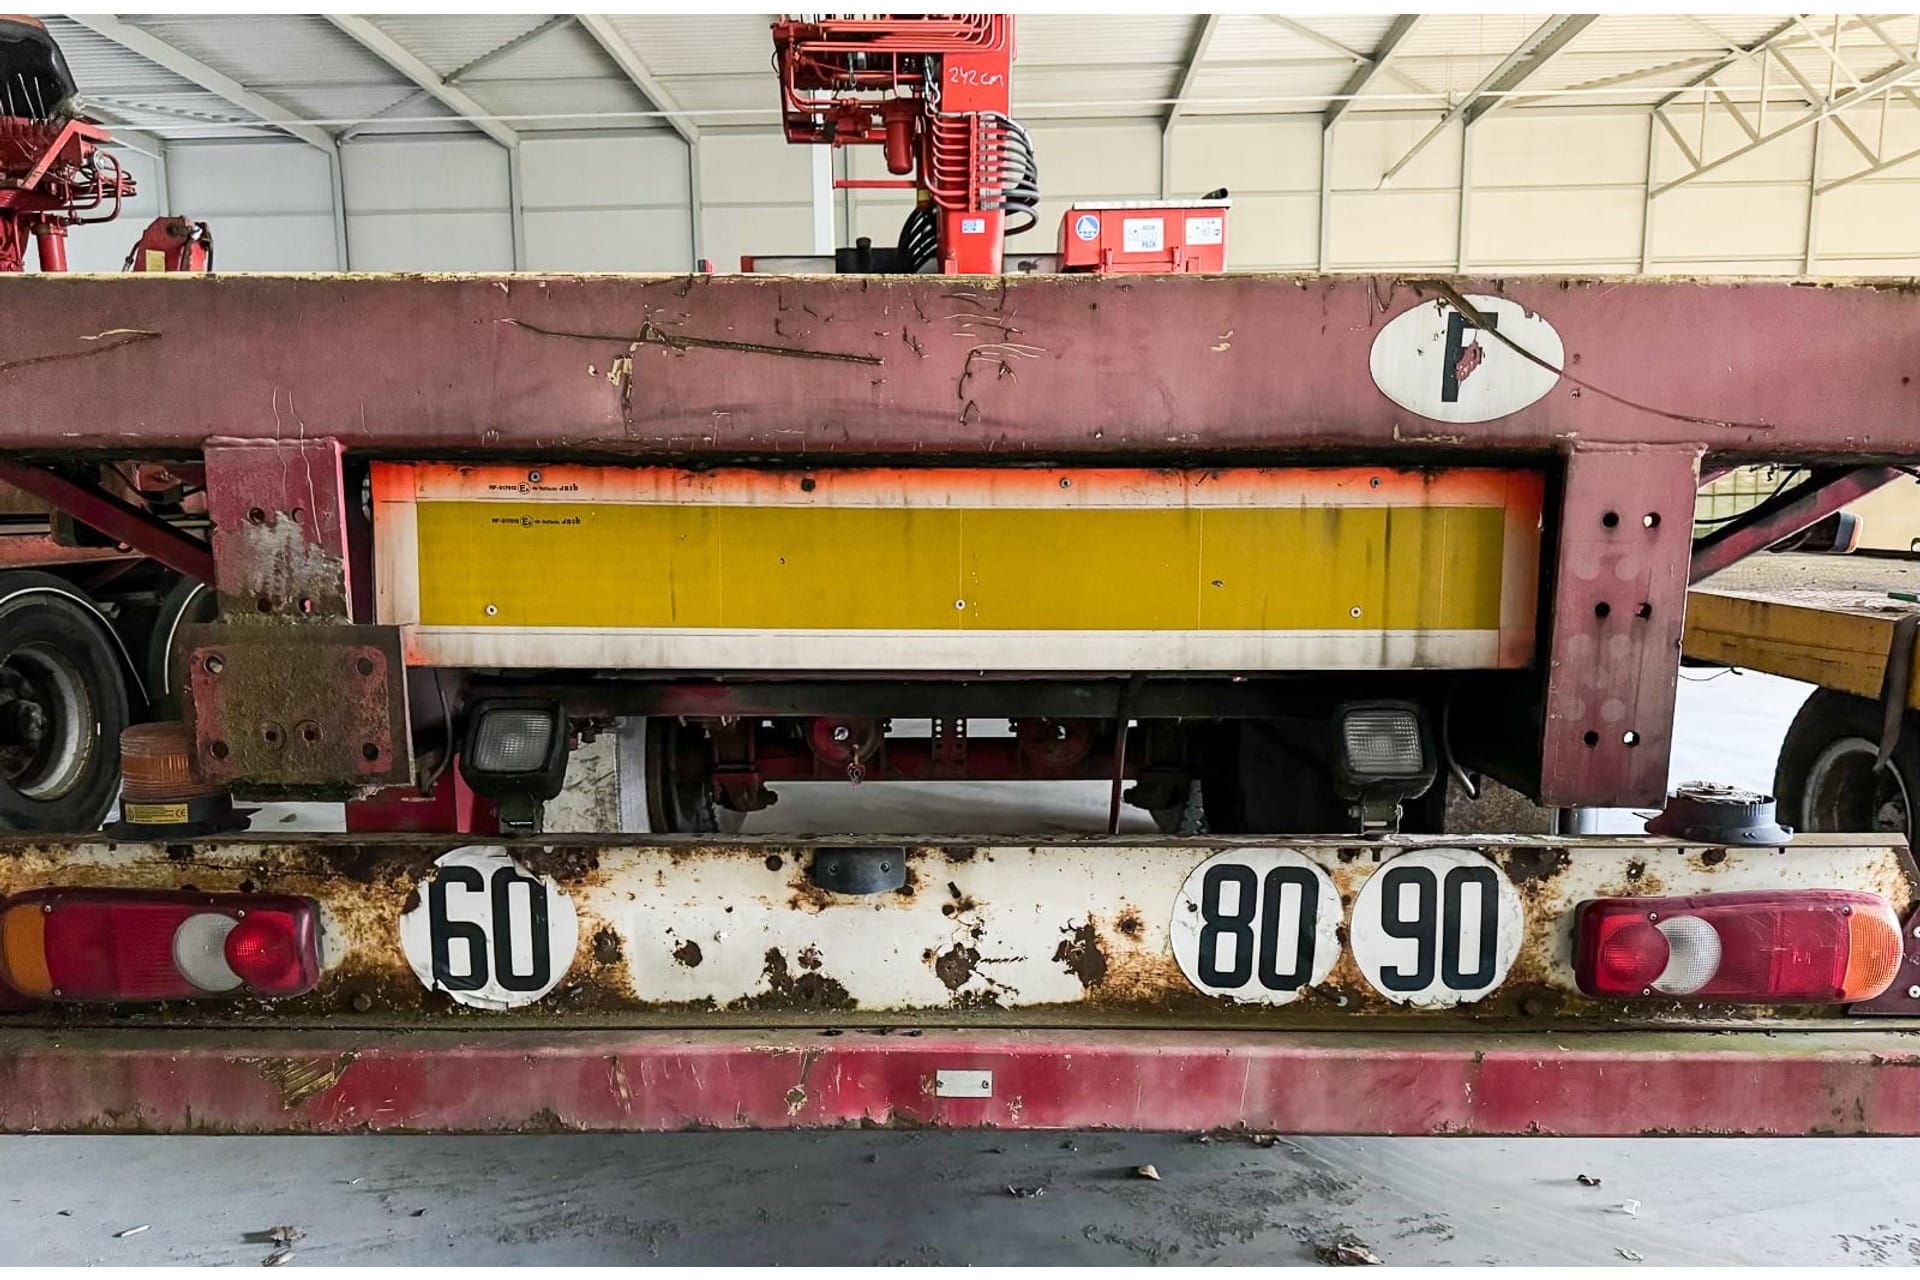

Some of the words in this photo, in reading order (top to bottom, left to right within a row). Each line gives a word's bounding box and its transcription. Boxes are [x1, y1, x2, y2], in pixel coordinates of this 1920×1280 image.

[949, 66, 979, 87] 242
[980, 72, 1004, 88] cm
[428, 865, 551, 991] 60
[1197, 863, 1320, 991] 80
[1380, 865, 1500, 992] 90
